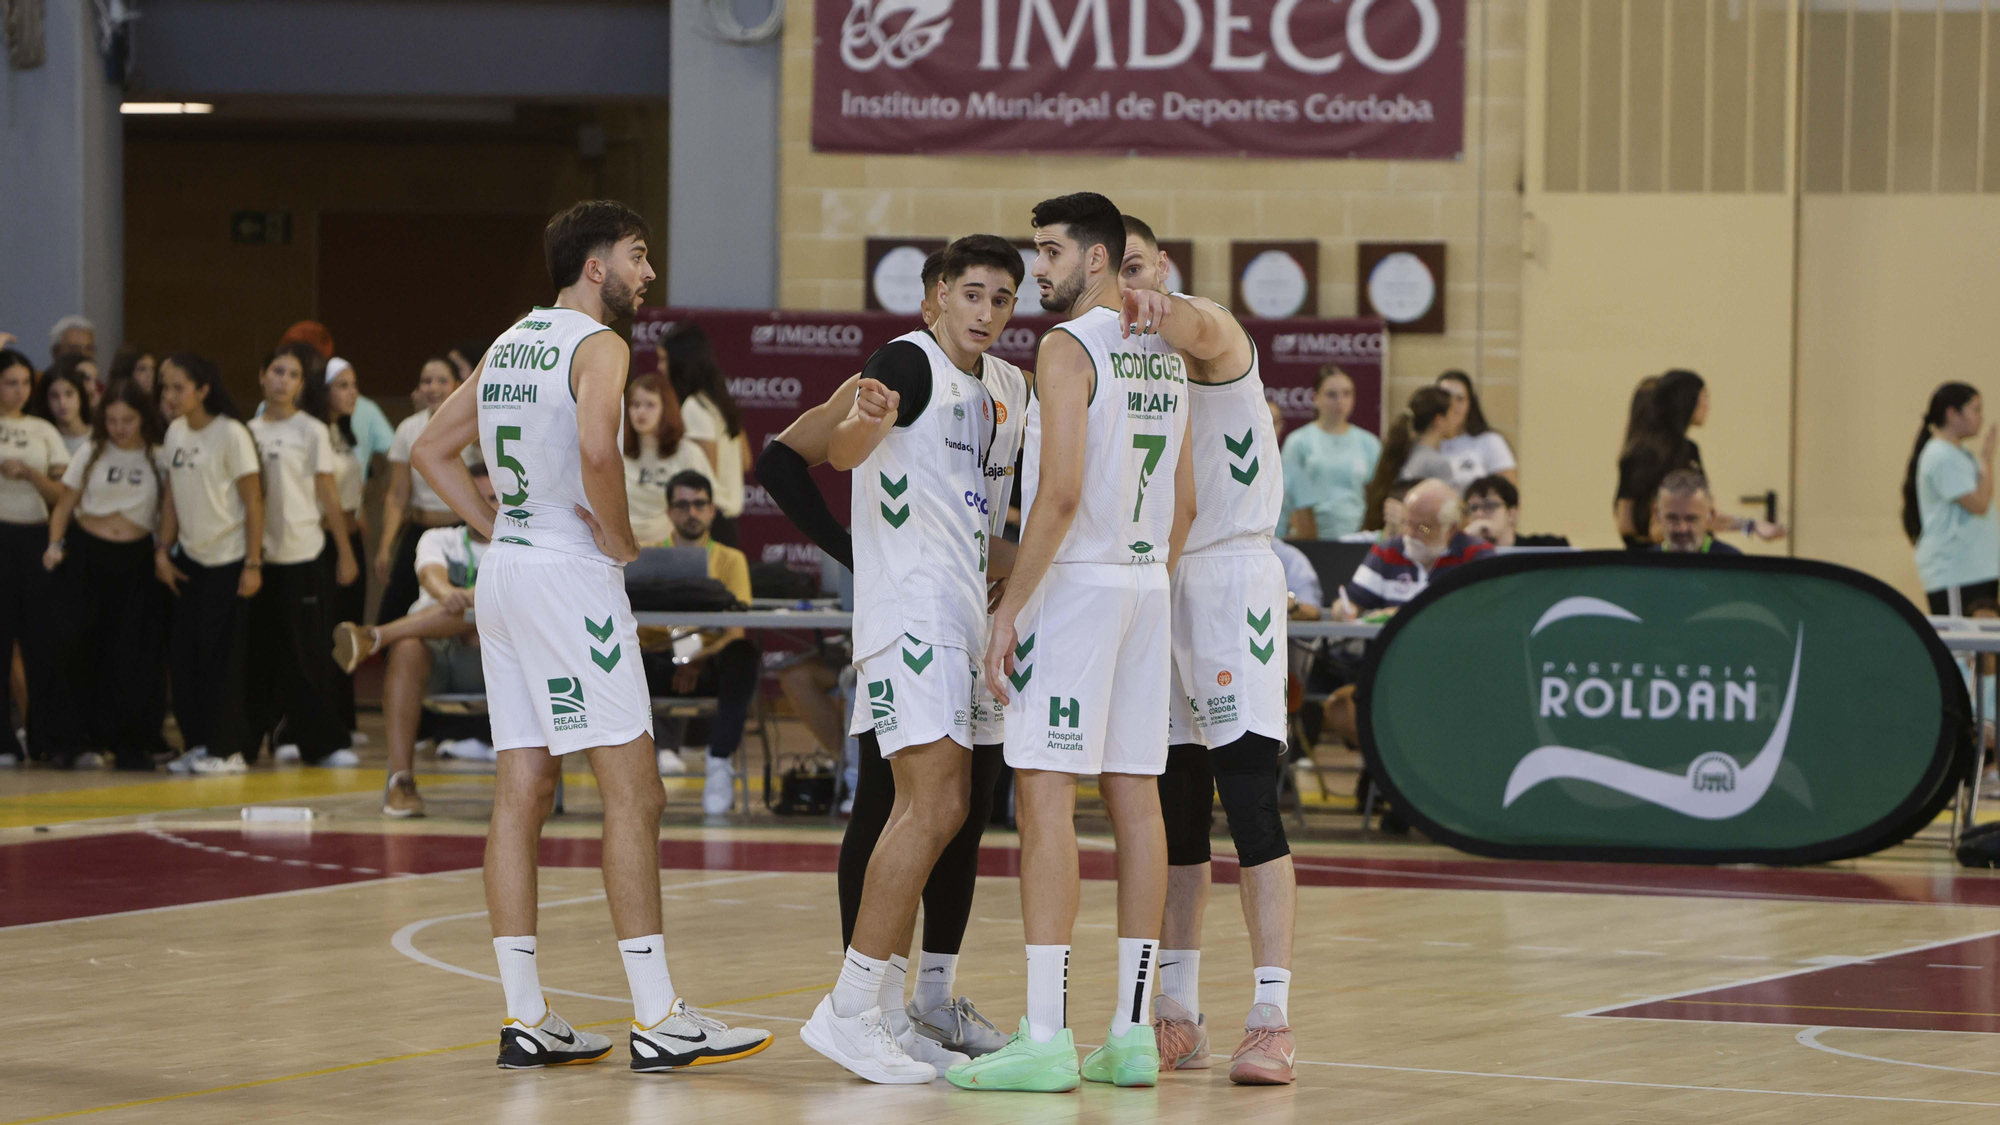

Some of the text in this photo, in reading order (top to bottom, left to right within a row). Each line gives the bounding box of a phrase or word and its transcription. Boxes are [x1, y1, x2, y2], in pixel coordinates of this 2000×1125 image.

[978, 0, 1440, 73] IMDECO
[841, 91, 1435, 127] Instituto Municipal de Deportes Córdoba
[775, 324, 863, 347] IMDECO
[1298, 333, 1382, 356] IMDECO
[502, 384, 538, 403] RAHI
[724, 376, 802, 400] MDECO
[496, 425, 529, 507] 5
[1133, 434, 1167, 522] 7
[1542, 661, 1757, 677] PASTELERIA
[1540, 676, 1757, 721] ROLDAN
[553, 714, 588, 726] REALE
[554, 722, 588, 732] SEGUROS
[874, 716, 898, 730] REALE
[1046, 740, 1084, 751] Arruzafa
[1048, 730, 1084, 742] Hospital
